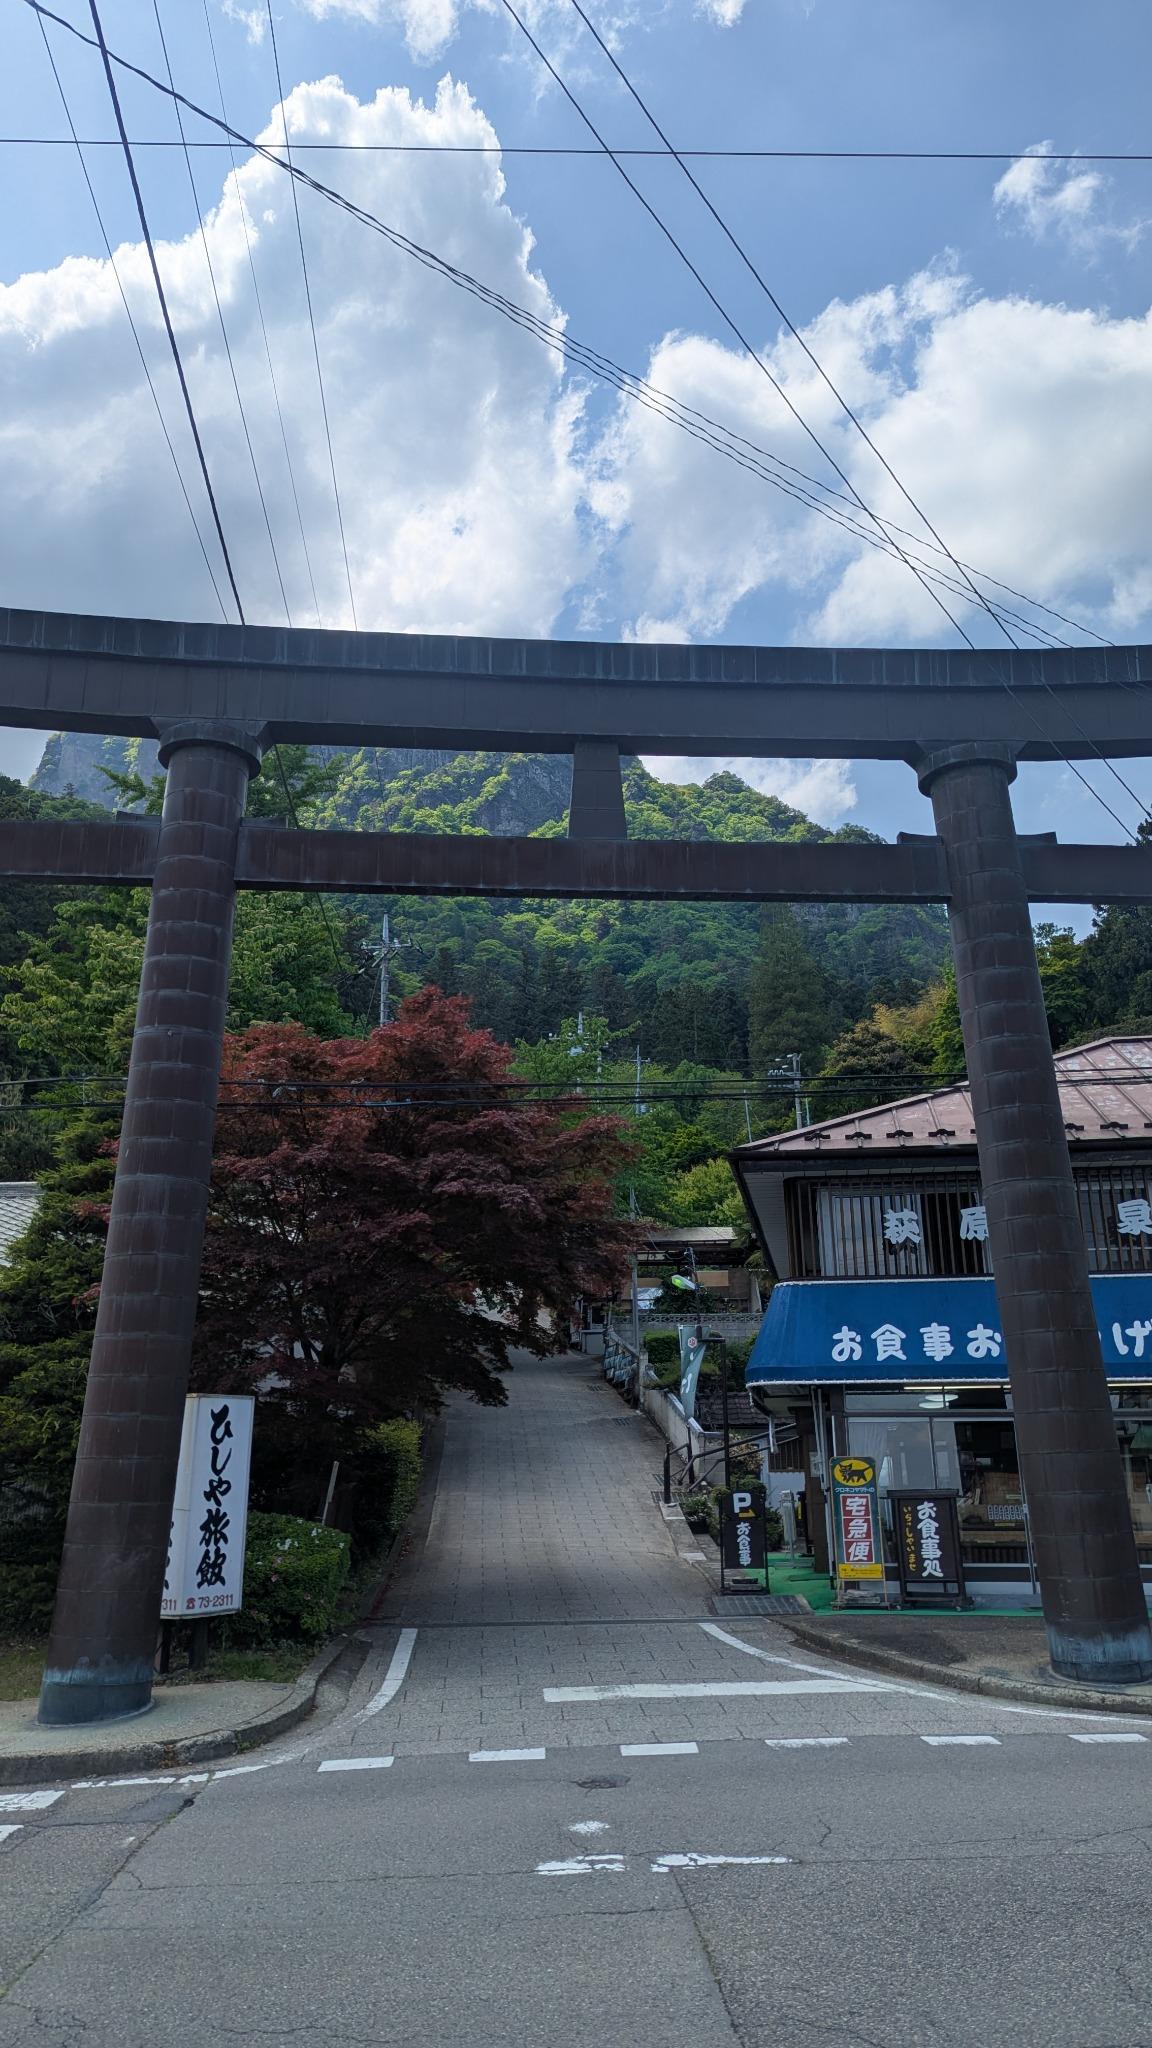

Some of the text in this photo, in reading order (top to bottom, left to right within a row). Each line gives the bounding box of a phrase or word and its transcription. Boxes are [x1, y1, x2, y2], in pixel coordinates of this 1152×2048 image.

[733, 1492, 752, 1513] P
[736, 1521, 752, 1567] お食事
[845, 1497, 870, 1562] 宅急便
[916, 1501, 944, 1577] お食事処
[198, 1594, 233, 1609] 73-2311
